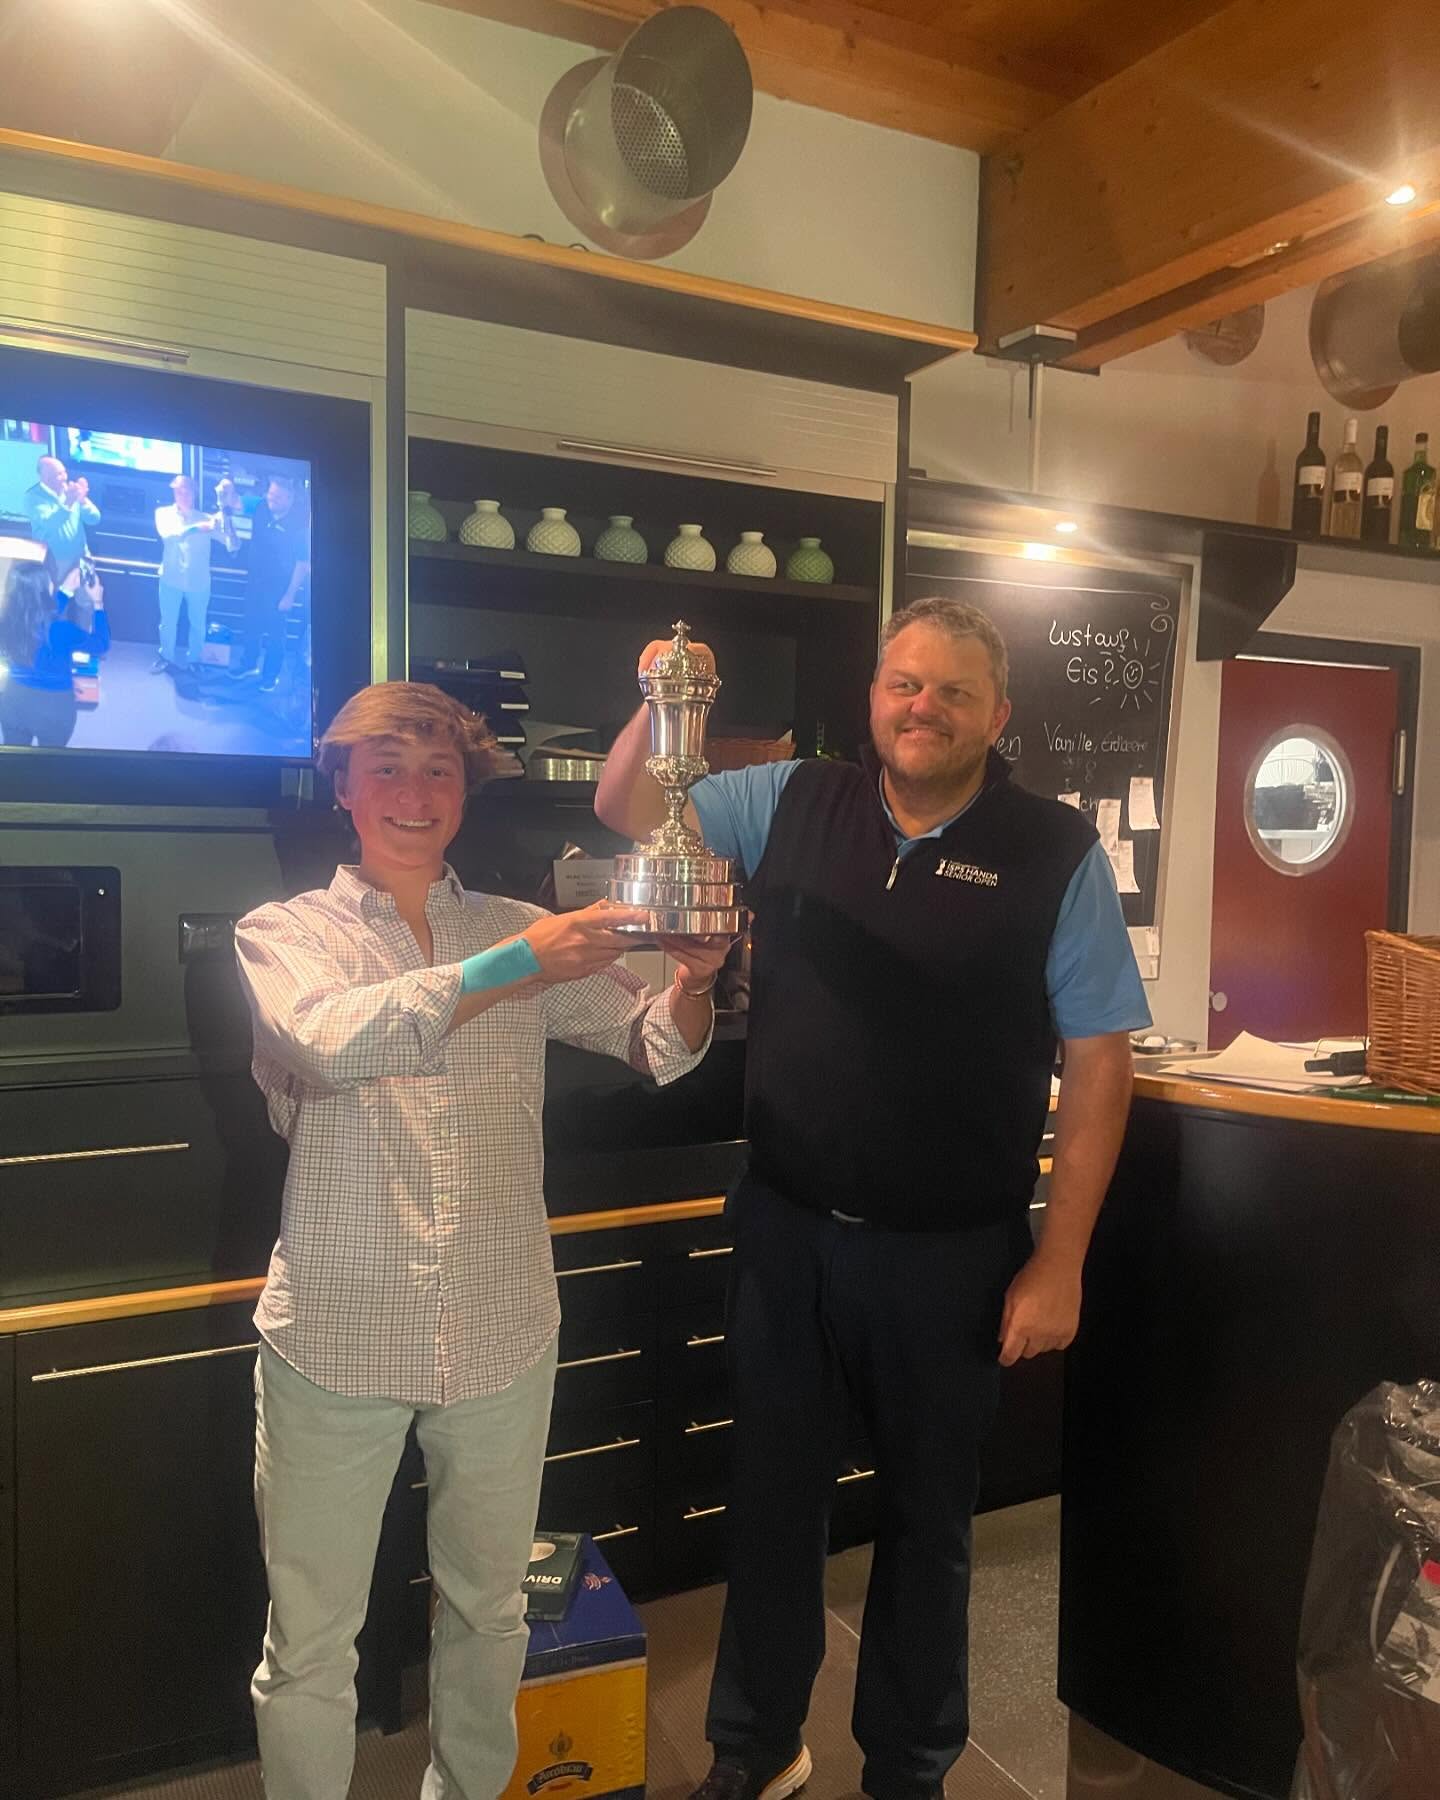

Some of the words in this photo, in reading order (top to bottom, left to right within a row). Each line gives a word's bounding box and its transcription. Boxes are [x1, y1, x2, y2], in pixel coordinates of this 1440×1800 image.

[997, 735, 1021, 756] en
[943, 870, 973, 882] SENIOR
[974, 877, 998, 886] OPEN
[947, 863, 965, 873] ISPS
[966, 867, 998, 881] HANDA
[522, 1574, 563, 1585] DRIV
